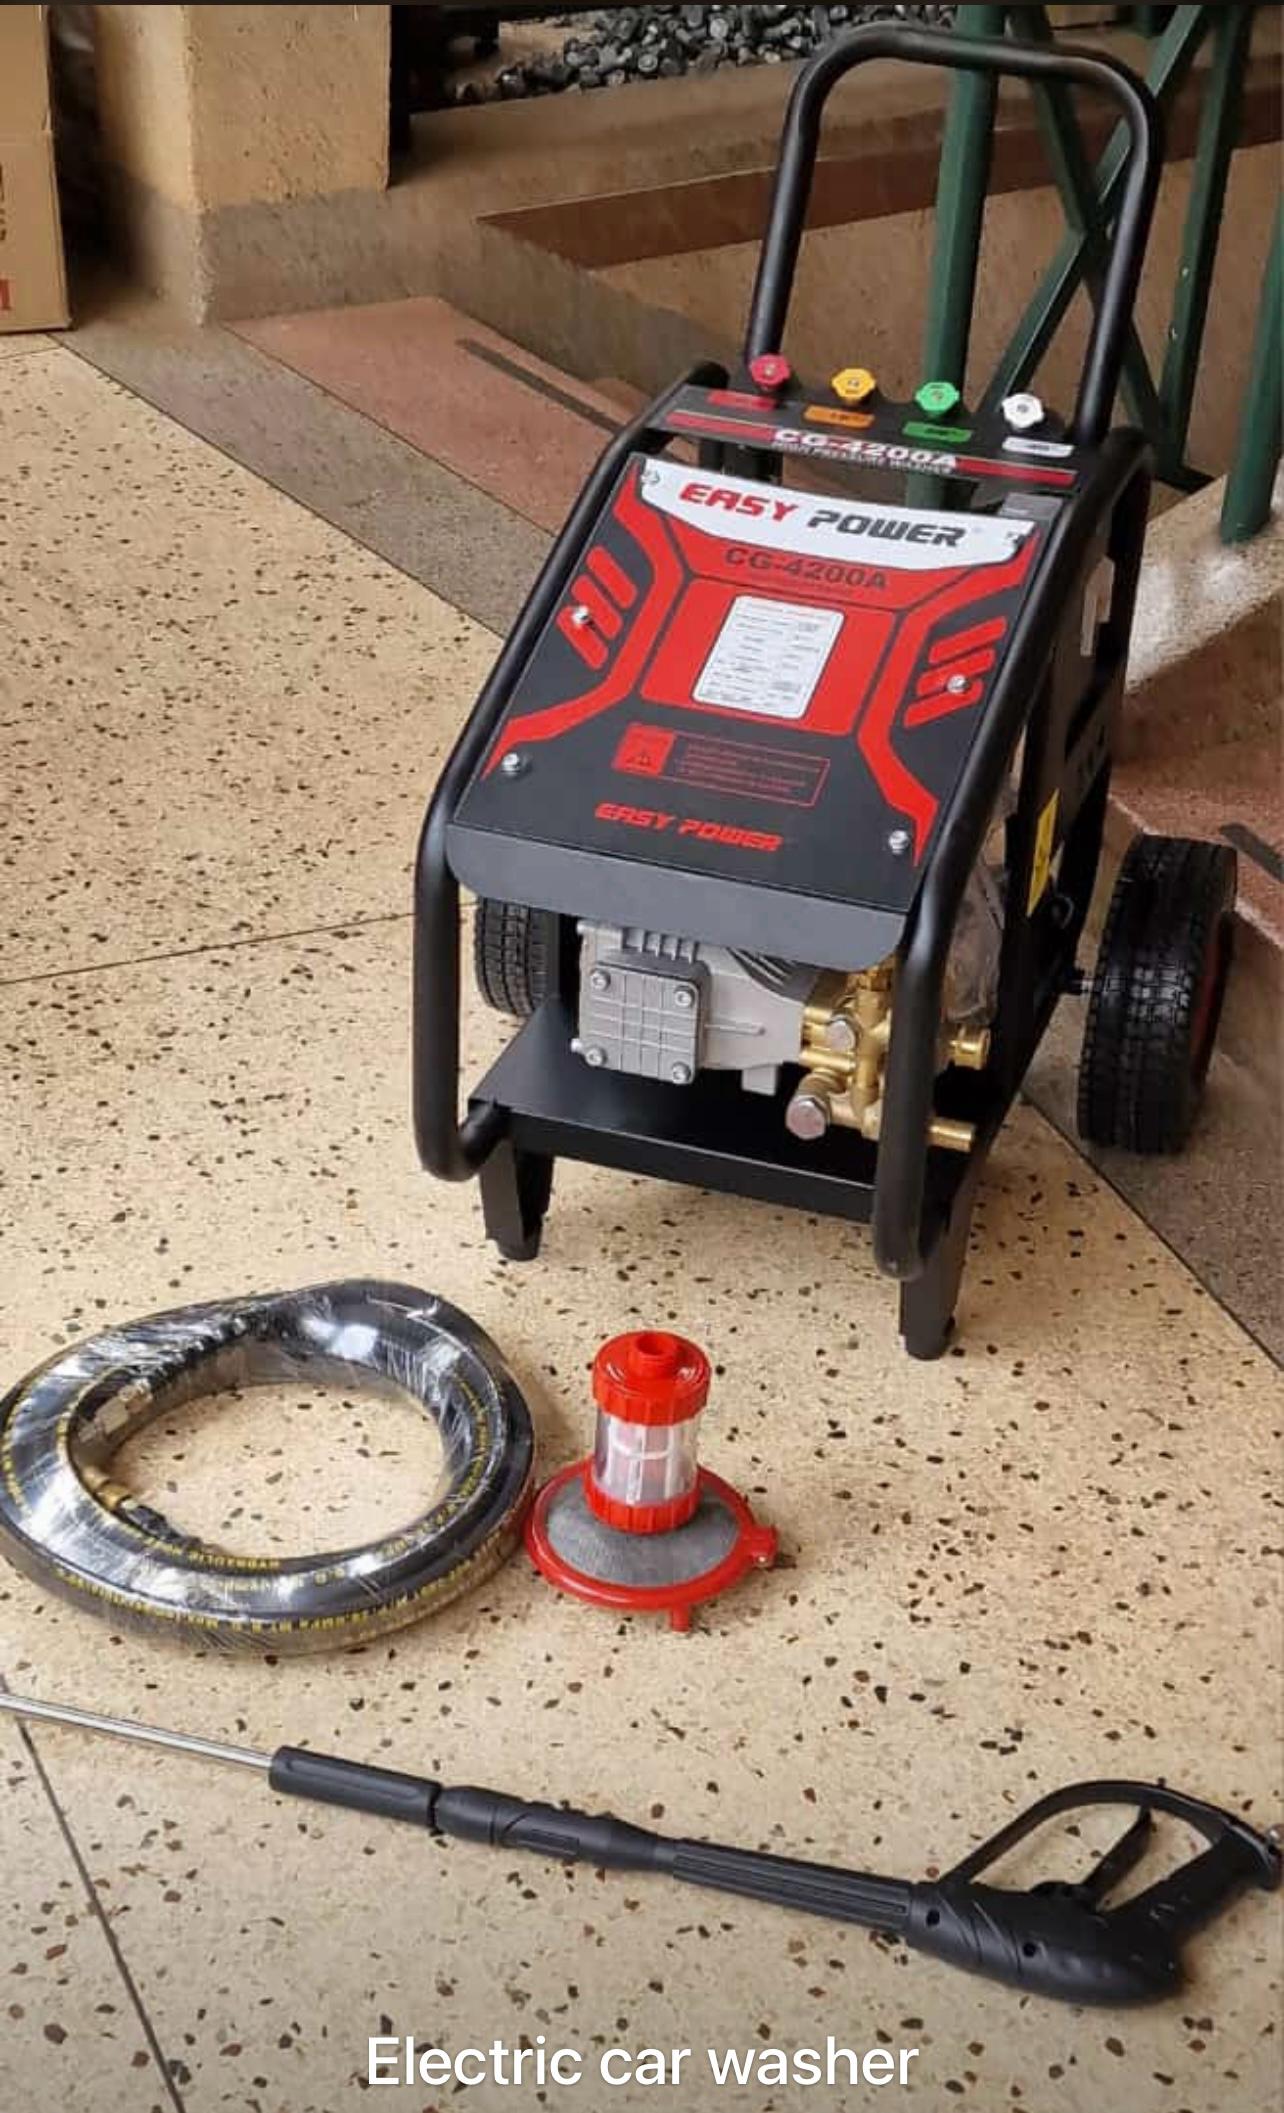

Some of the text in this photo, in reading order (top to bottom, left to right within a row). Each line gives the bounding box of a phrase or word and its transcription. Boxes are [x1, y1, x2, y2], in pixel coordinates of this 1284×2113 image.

[774, 428, 956, 468] CG-4200A
[679, 485, 967, 547] EASY POWER
[725, 547, 887, 590] CG-4200A
[595, 803, 784, 851] EASY POWER
